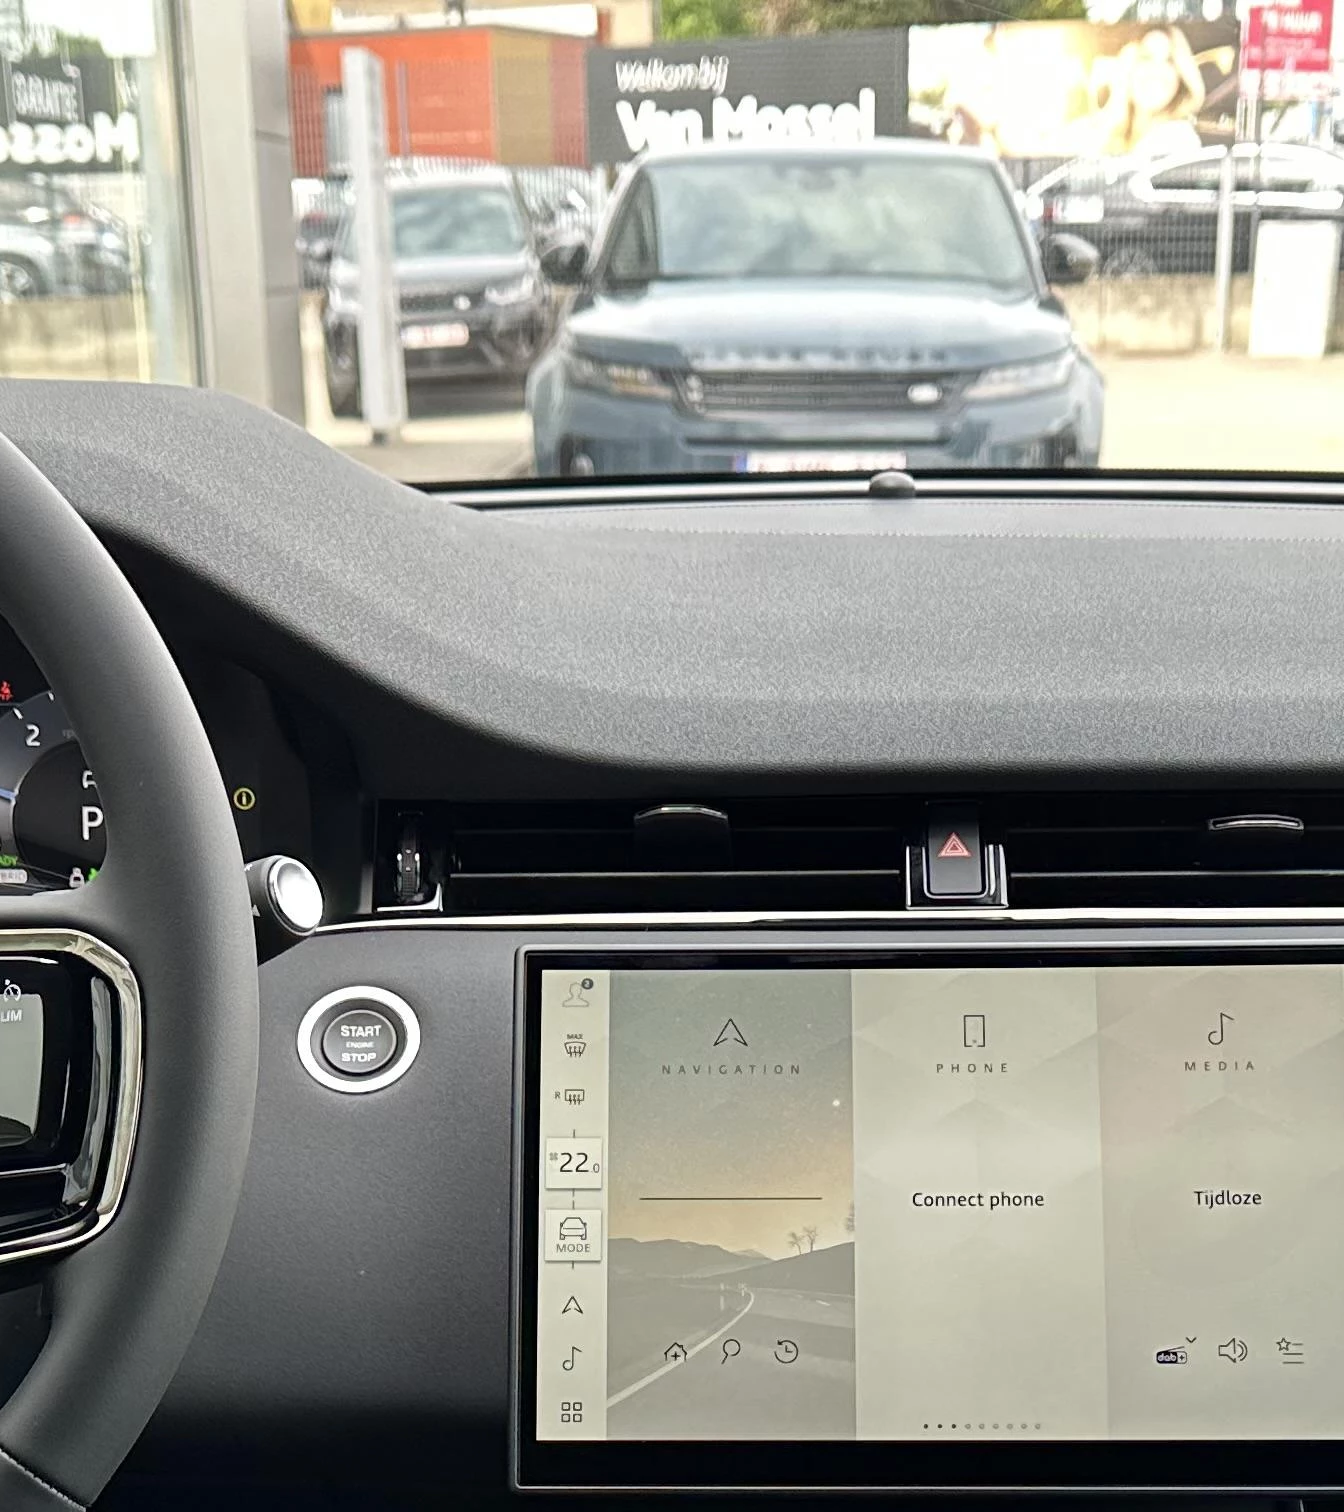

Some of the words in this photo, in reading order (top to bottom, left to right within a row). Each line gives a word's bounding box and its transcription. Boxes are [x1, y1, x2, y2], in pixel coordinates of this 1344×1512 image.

[616, 99, 703, 151] Van
[712, 87, 876, 142] Mossel
[25, 724, 41, 748] 2
[81, 805, 104, 841] P
[0, 1009, 23, 1022] LIM
[341, 1025, 382, 1037] START
[342, 1053, 376, 1062] STOP
[661, 1063, 802, 1076] NAVIGATION
[936, 1062, 1009, 1074] PHONE
[1184, 1060, 1256, 1072] MEDIA
[911, 1191, 985, 1208] Connect
[989, 1190, 1045, 1210] phone
[1193, 1190, 1263, 1209] Tijdloze
[555, 1242, 591, 1254] MODE
